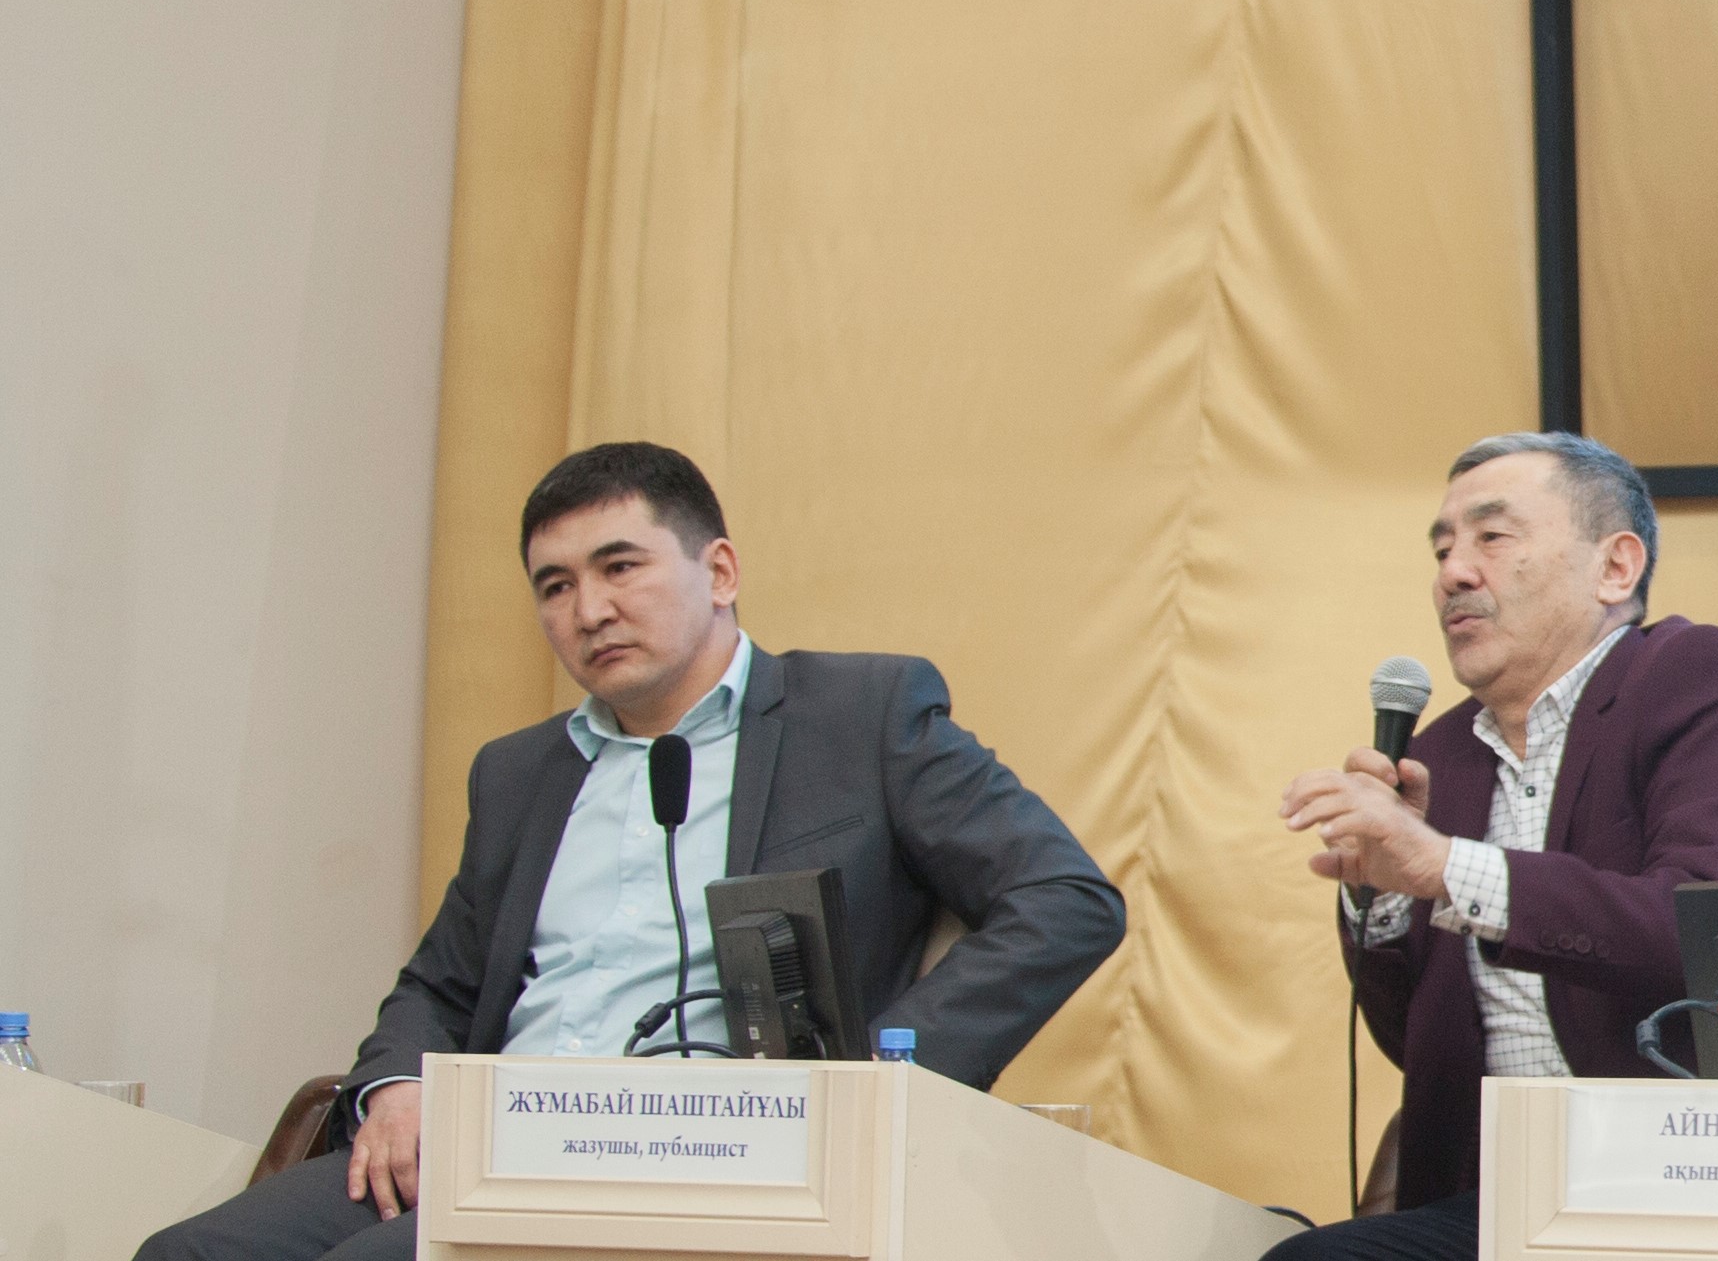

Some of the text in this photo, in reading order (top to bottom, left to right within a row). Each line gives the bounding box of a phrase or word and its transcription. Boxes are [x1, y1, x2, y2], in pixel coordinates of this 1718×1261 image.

[507, 1087, 807, 1119] ЖҰМАБАЙ ШАШТАЙҰЛЫ
[562, 1135, 749, 1162] жазушы, публицист
